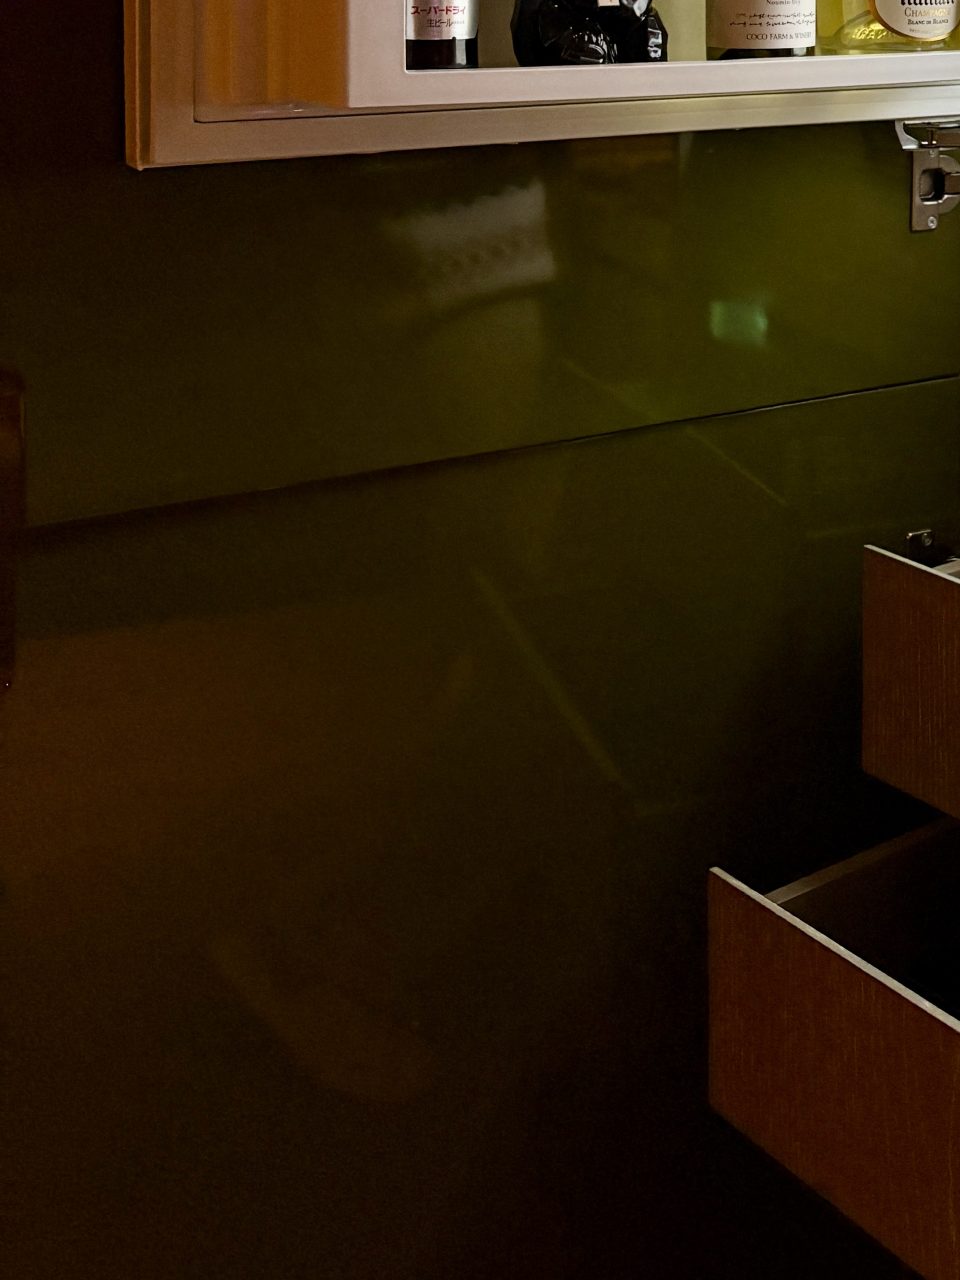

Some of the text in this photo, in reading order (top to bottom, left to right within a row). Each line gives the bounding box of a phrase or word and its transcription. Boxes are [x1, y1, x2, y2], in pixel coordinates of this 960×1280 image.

[410, 5, 466, 16] スーパードライ
[426, 19, 453, 28] 生ビール
